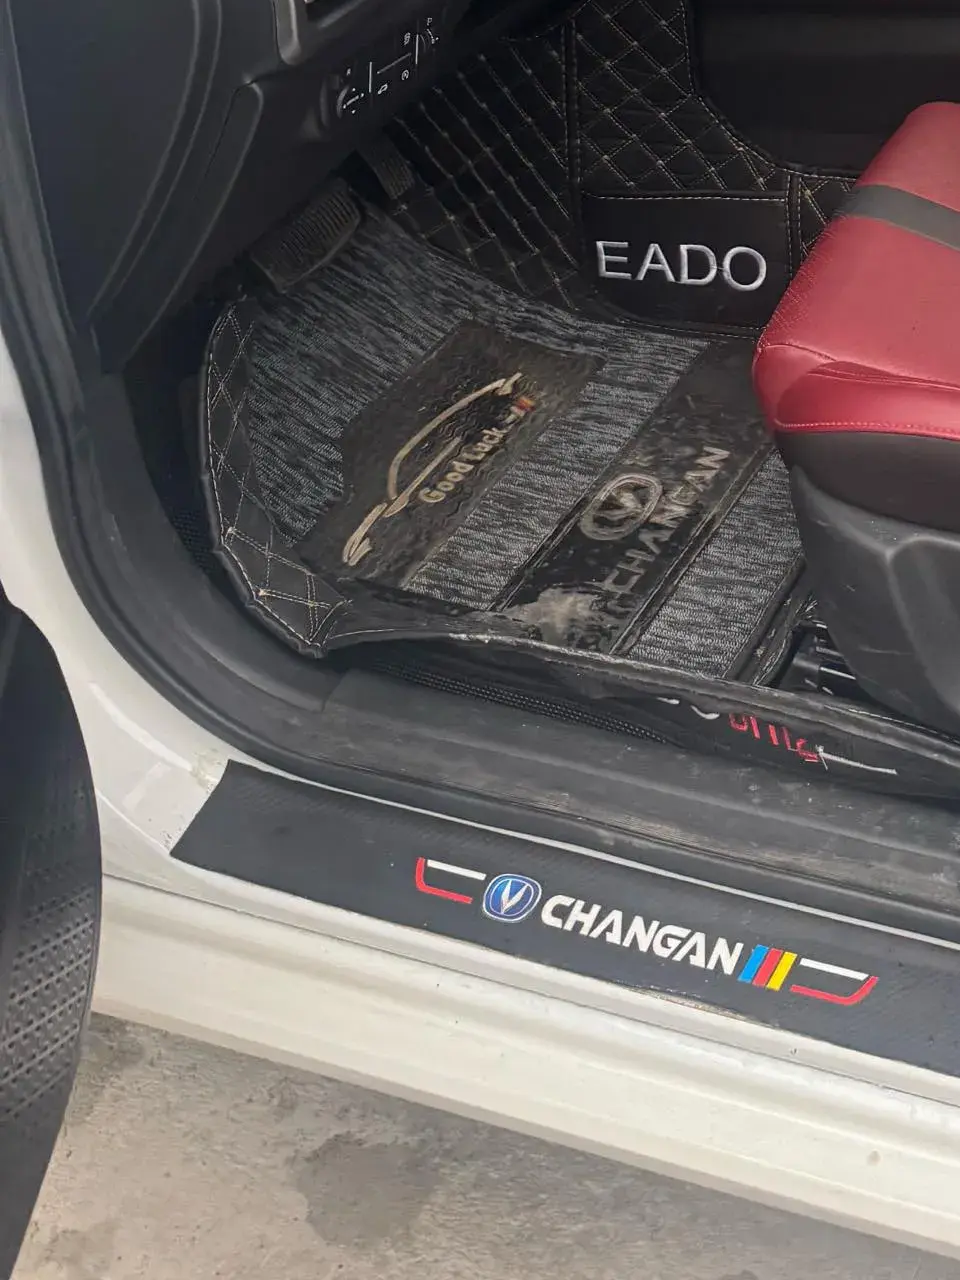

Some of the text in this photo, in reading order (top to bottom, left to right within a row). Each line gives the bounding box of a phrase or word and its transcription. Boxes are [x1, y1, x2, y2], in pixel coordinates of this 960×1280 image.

[596, 241, 767, 291] EADO
[418, 461, 475, 503] Good
[541, 894, 744, 975] CHANGAN
